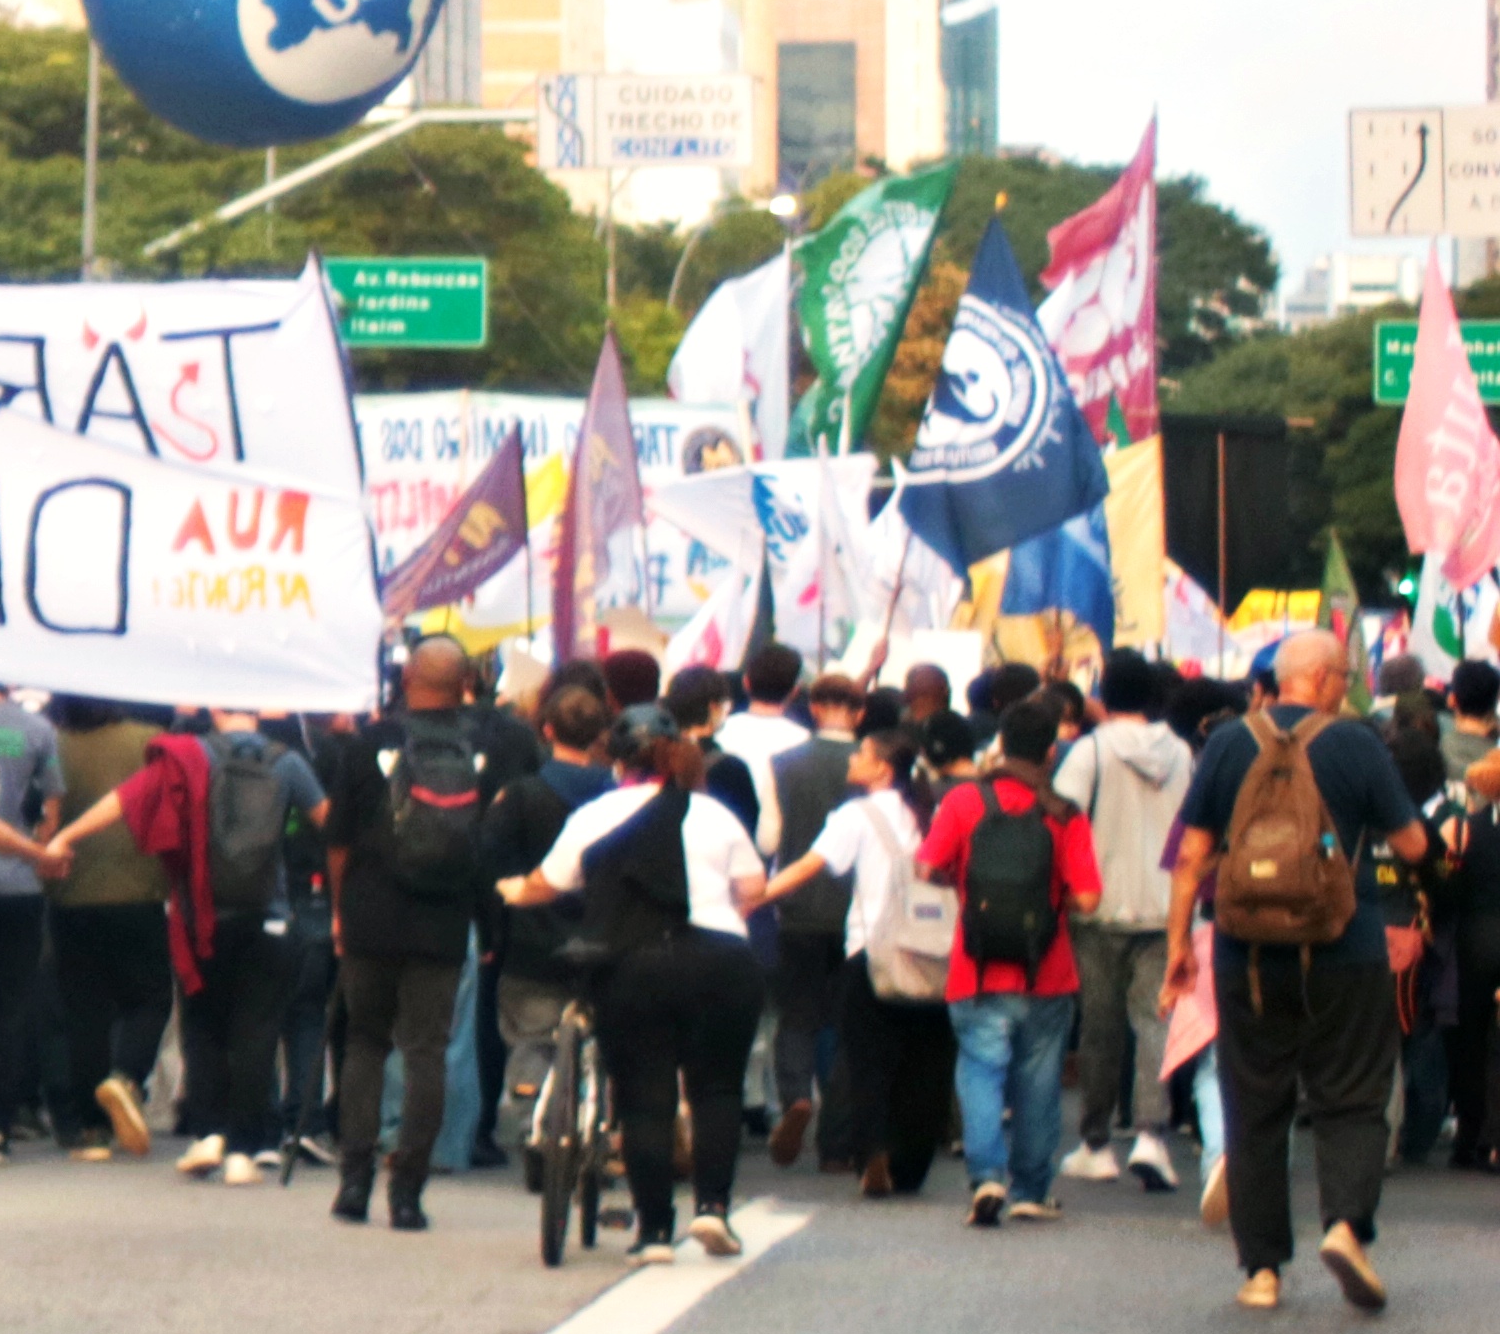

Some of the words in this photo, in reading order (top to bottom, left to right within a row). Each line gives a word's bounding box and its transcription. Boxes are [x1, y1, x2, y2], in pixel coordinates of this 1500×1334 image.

[618, 84, 734, 106] CUIDADO
[606, 111, 705, 131] TRECHO
[710, 111, 742, 131] DE
